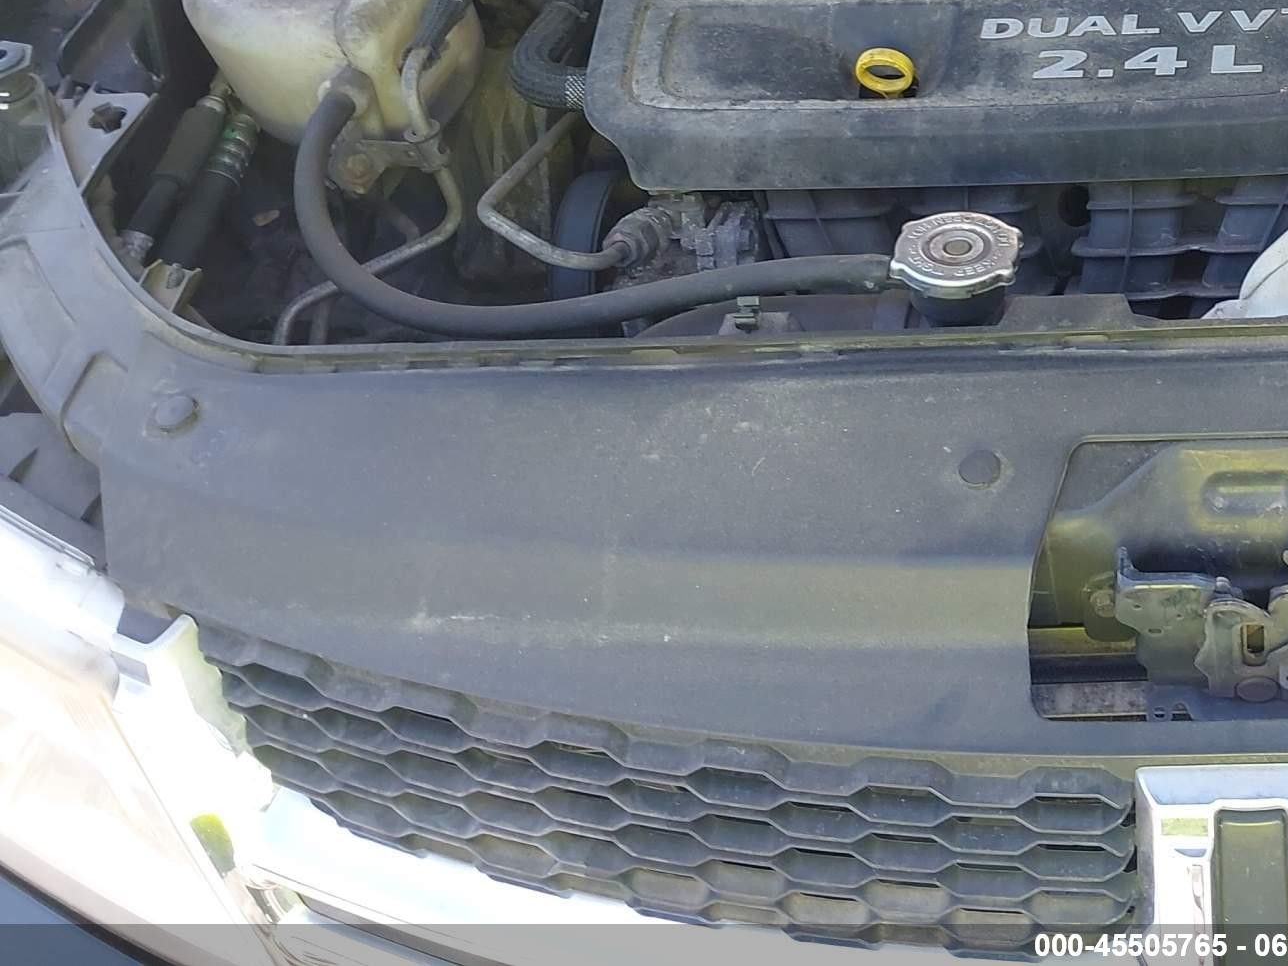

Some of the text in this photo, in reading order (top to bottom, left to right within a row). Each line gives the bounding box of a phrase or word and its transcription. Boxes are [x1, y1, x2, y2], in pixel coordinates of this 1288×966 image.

[980, 13, 1160, 39] DUAL
[1032, 44, 1263, 79] 2.4 L
